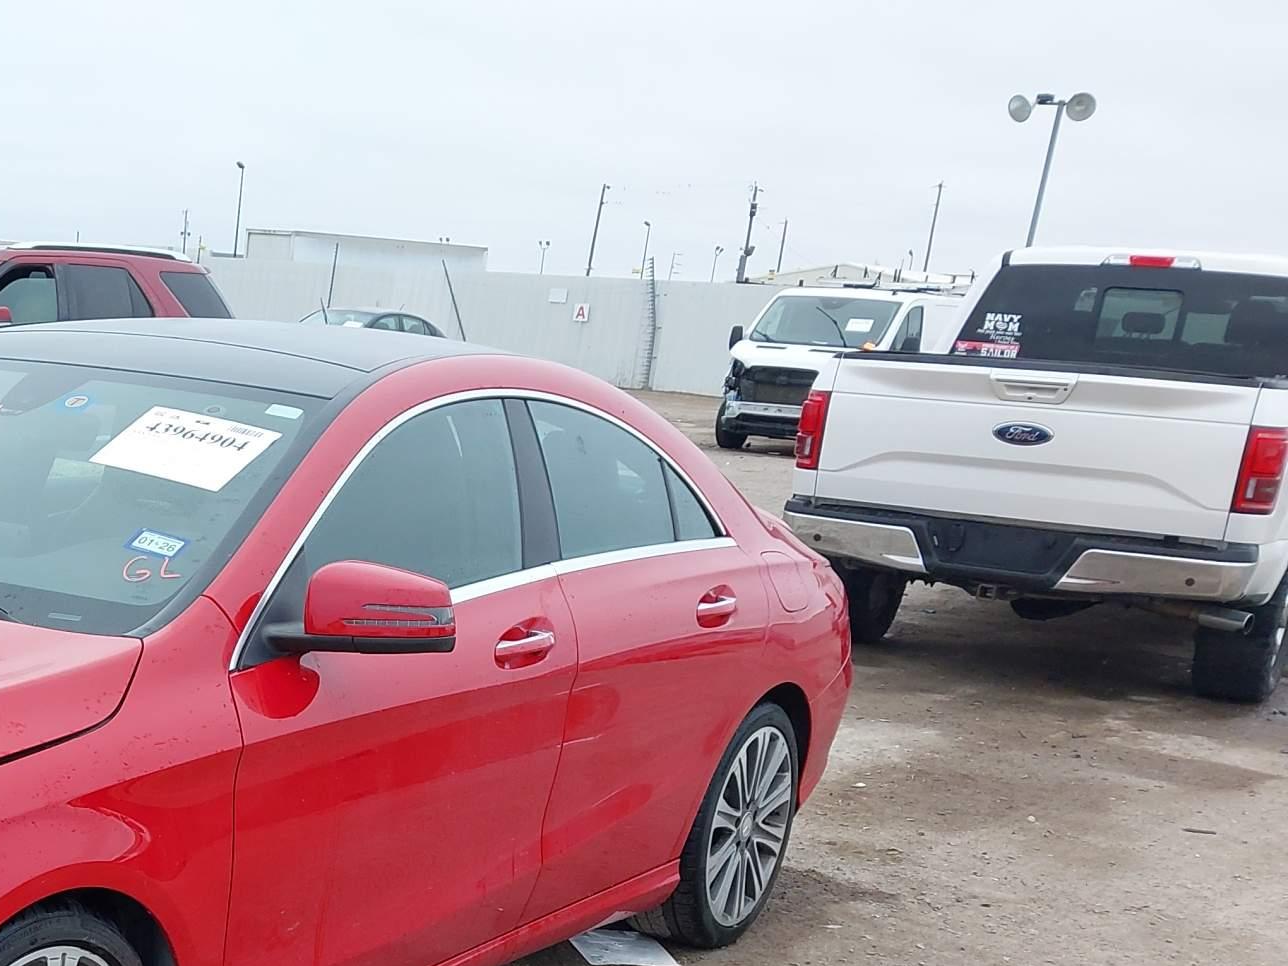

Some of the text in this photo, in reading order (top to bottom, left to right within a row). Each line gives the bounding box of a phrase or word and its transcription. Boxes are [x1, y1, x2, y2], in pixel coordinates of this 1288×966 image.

[575, 305, 585, 319] A
[985, 312, 1022, 322] NAVY
[980, 347, 1018, 359] SAILOR
[145, 421, 251, 452] 43964904
[1005, 425, 1040, 441] Ford
